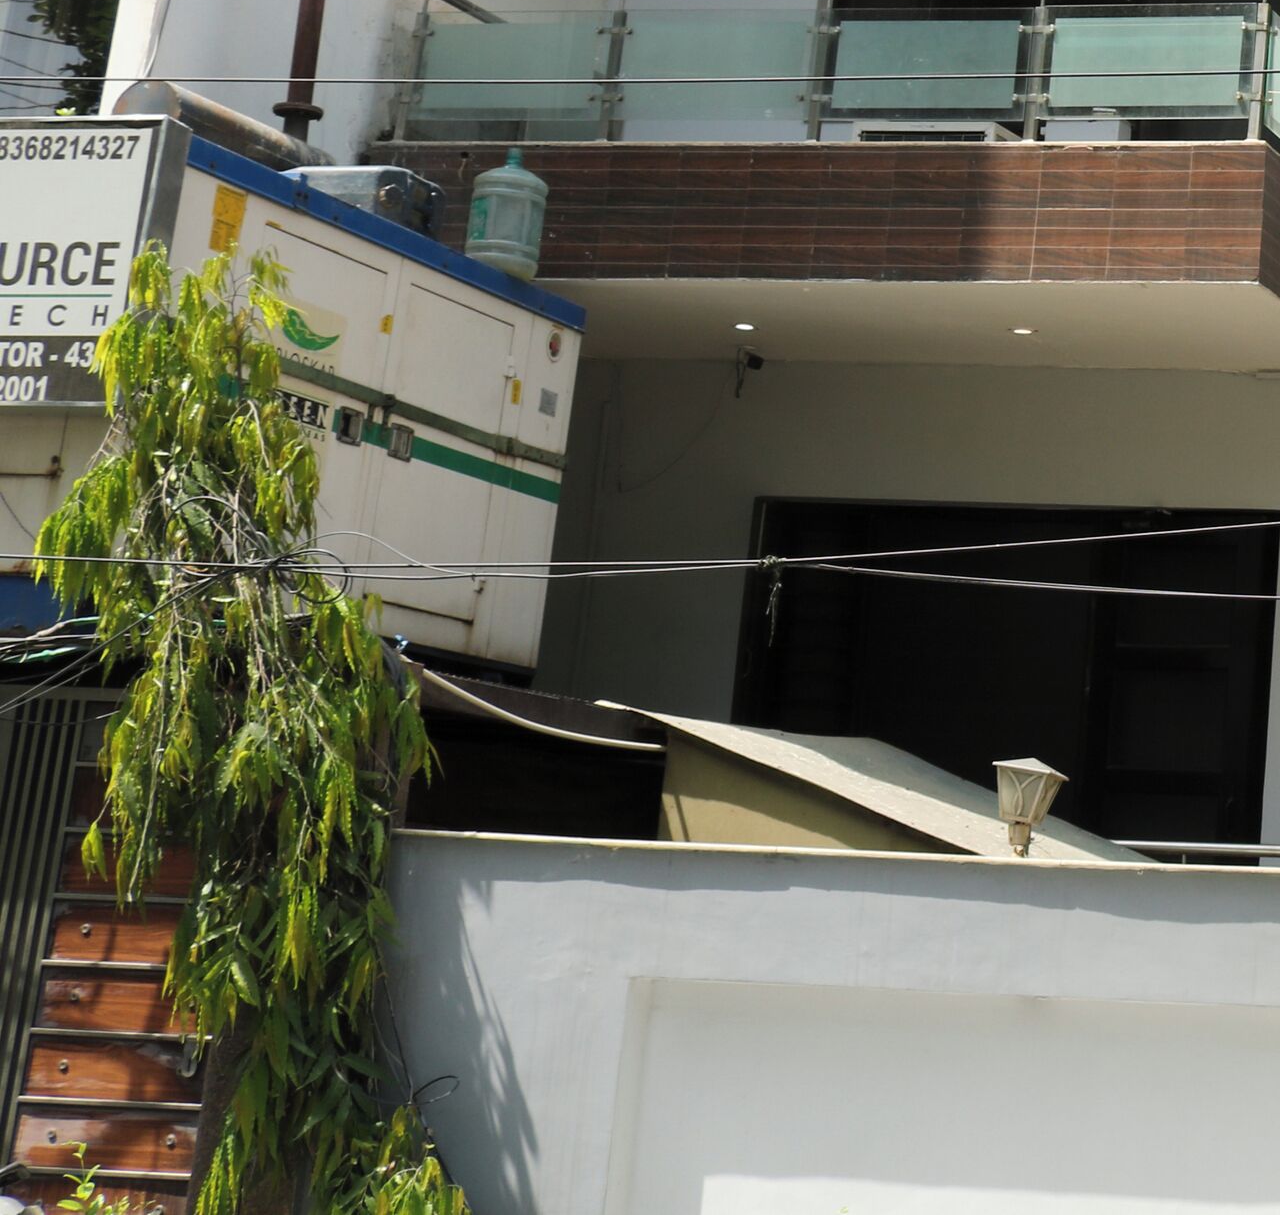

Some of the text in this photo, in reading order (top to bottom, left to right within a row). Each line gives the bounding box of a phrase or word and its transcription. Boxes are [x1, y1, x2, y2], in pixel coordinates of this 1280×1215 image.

[0, 135, 140, 160] 8368214327
[0, 241, 121, 287] URCE
[64, 341, 95, 368] 43
